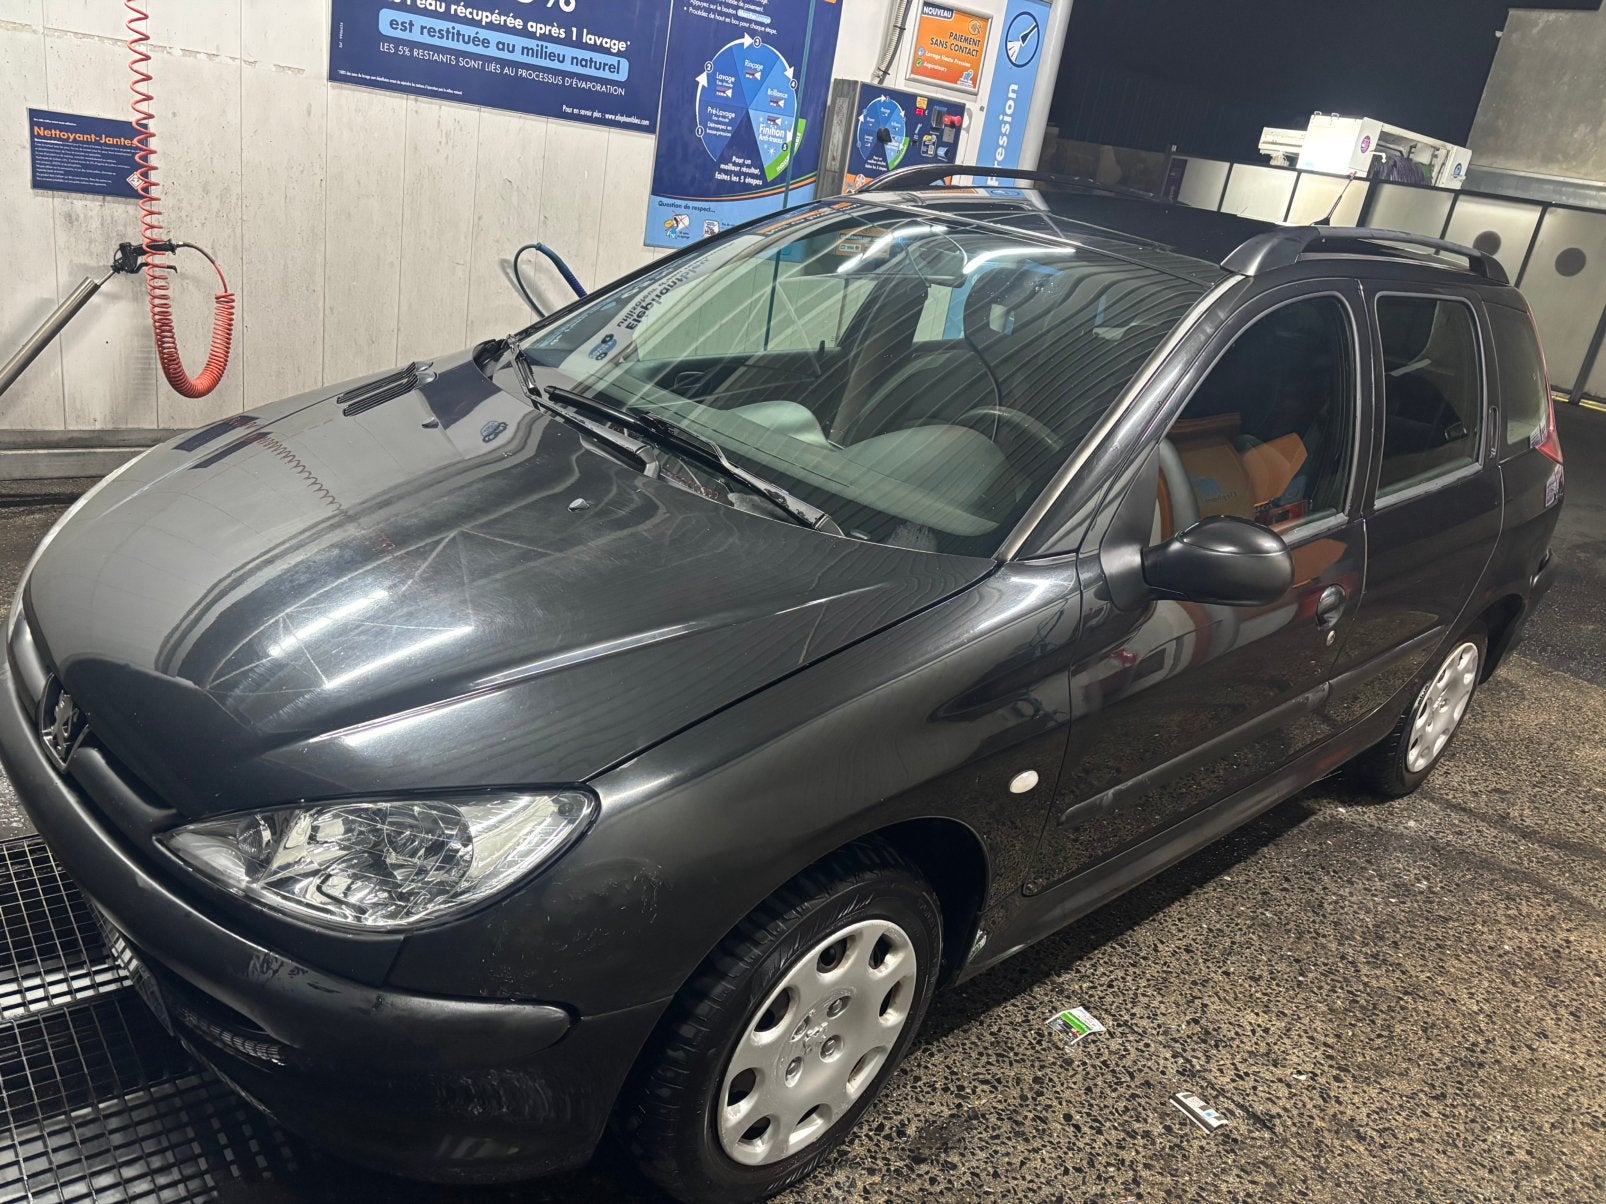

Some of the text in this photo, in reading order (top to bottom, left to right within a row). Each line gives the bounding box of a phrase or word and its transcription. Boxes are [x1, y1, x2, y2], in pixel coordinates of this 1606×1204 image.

[721, 4, 736, 15] bouton
[923, 6, 952, 18] NOUVEAU
[450, 2, 524, 29] récupérée
[527, 21, 566, 39] après
[571, 27, 578, 41] 1
[739, 20, 750, 28] pour
[750, 21, 765, 31] chaque
[389, 16, 621, 75] est restituée au milieu naturel
[949, 31, 981, 47] PAIEMENT
[929, 37, 980, 58] SANS CONTACT
[380, 42, 625, 96] LES 5% RESTANTS SONT LIÉS AU PROCESSUS D'ÉVAPORATION
[716, 72, 736, 83] Lavage
[767, 88, 788, 98] Brillance
[562, 104, 573, 113] Pour
[592, 109, 602, 119] plus
[33, 126, 137, 147] Nettoyant-Jantes
[759, 123, 785, 138] Finition
[732, 155, 744, 164] Pour
[720, 163, 740, 172] meilleur
[715, 172, 731, 181] faites
[731, 173, 739, 182] les
[745, 175, 763, 187] étapes
[658, 200, 683, 210] Question
